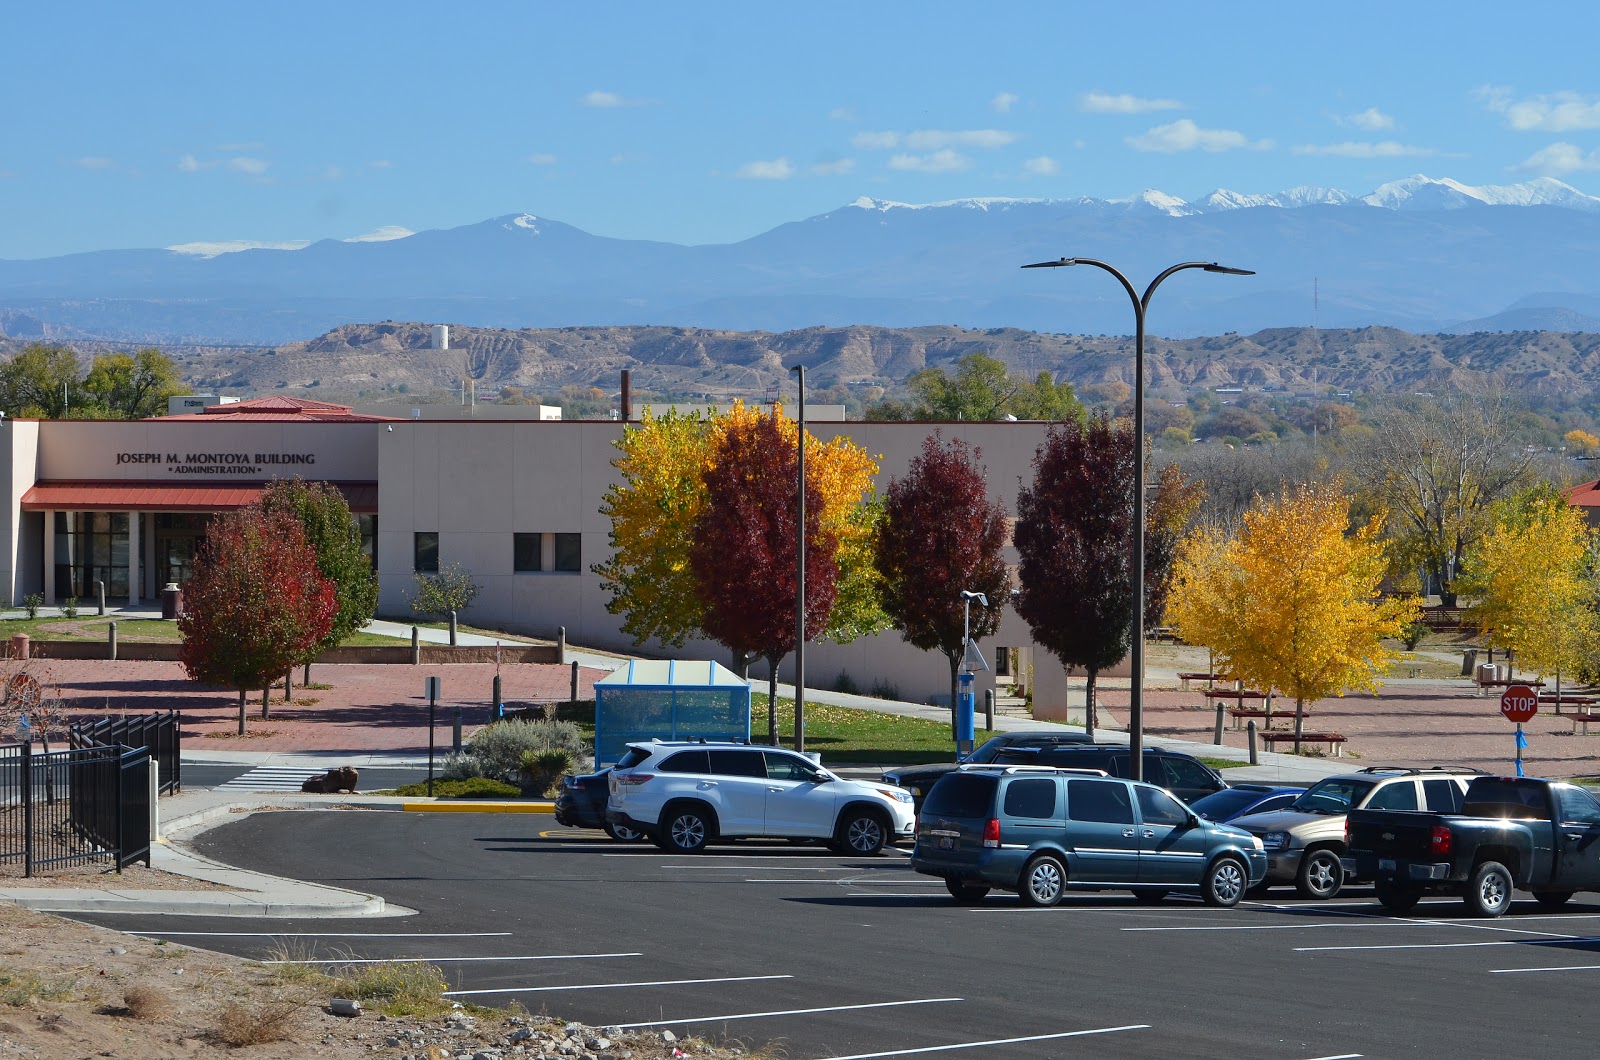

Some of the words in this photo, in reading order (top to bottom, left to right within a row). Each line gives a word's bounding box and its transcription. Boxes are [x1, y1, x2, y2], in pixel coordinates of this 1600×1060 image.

[116, 453, 161, 465] JOSEPH
[166, 453, 181, 464] M.
[185, 453, 250, 464] MONTOYA
[254, 453, 315, 465] BUILDING
[174, 466, 256, 474] ADMINISTRATION
[1503, 697, 1536, 712] STOP
